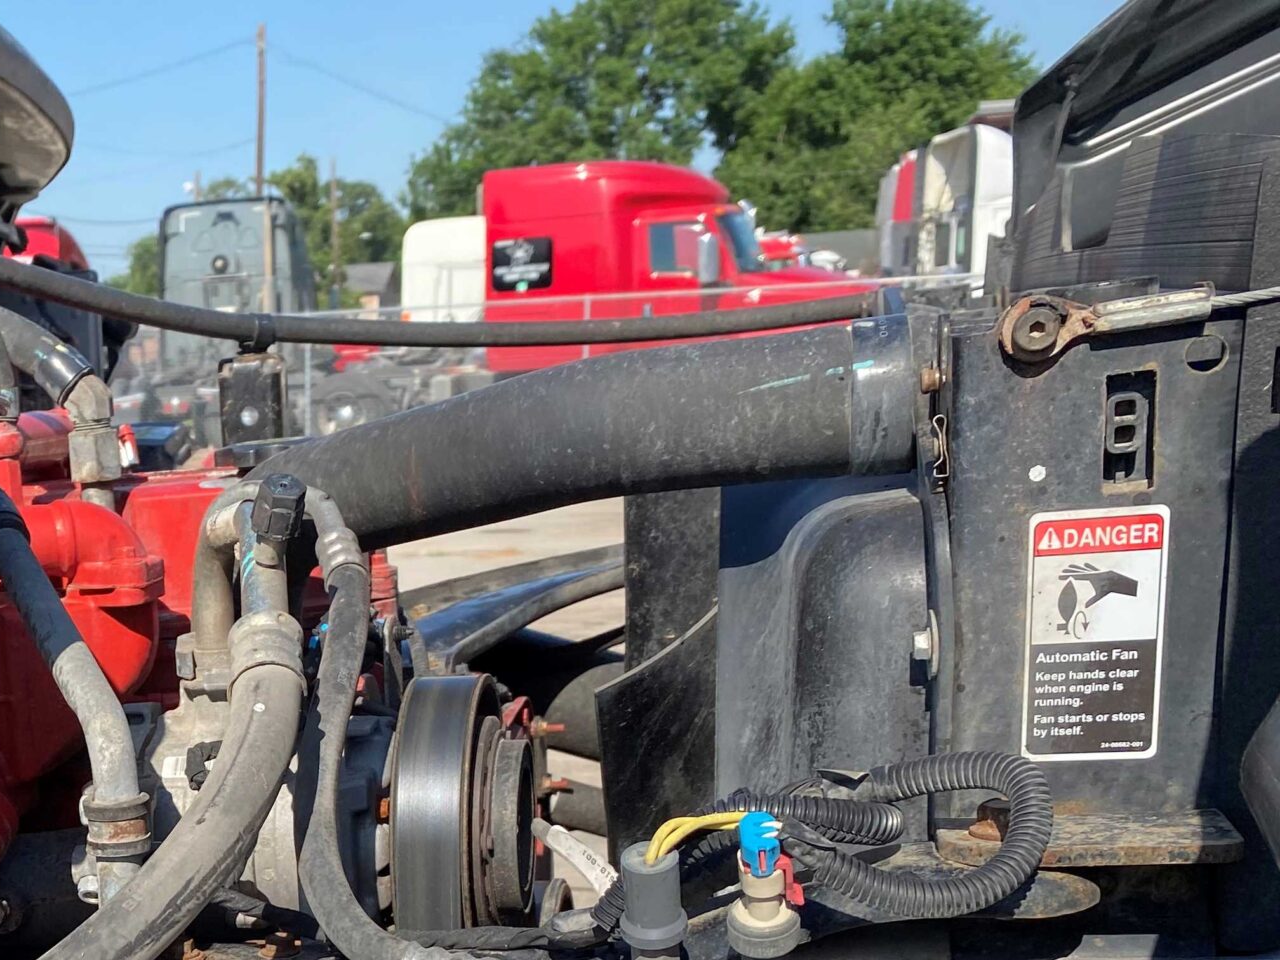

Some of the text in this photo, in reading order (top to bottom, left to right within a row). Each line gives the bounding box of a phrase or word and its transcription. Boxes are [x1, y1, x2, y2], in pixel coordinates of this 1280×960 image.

[1064, 523, 1160, 549] DANGER
[1035, 648, 1138, 664] Automatic Fan
[1035, 668, 1140, 682] Keep hands clear
[1035, 681, 1124, 694] when engine is
[1034, 696, 1084, 707] running.
[1033, 712, 1146, 724] Fan starts or stops
[1033, 726, 1084, 738] by itself.
